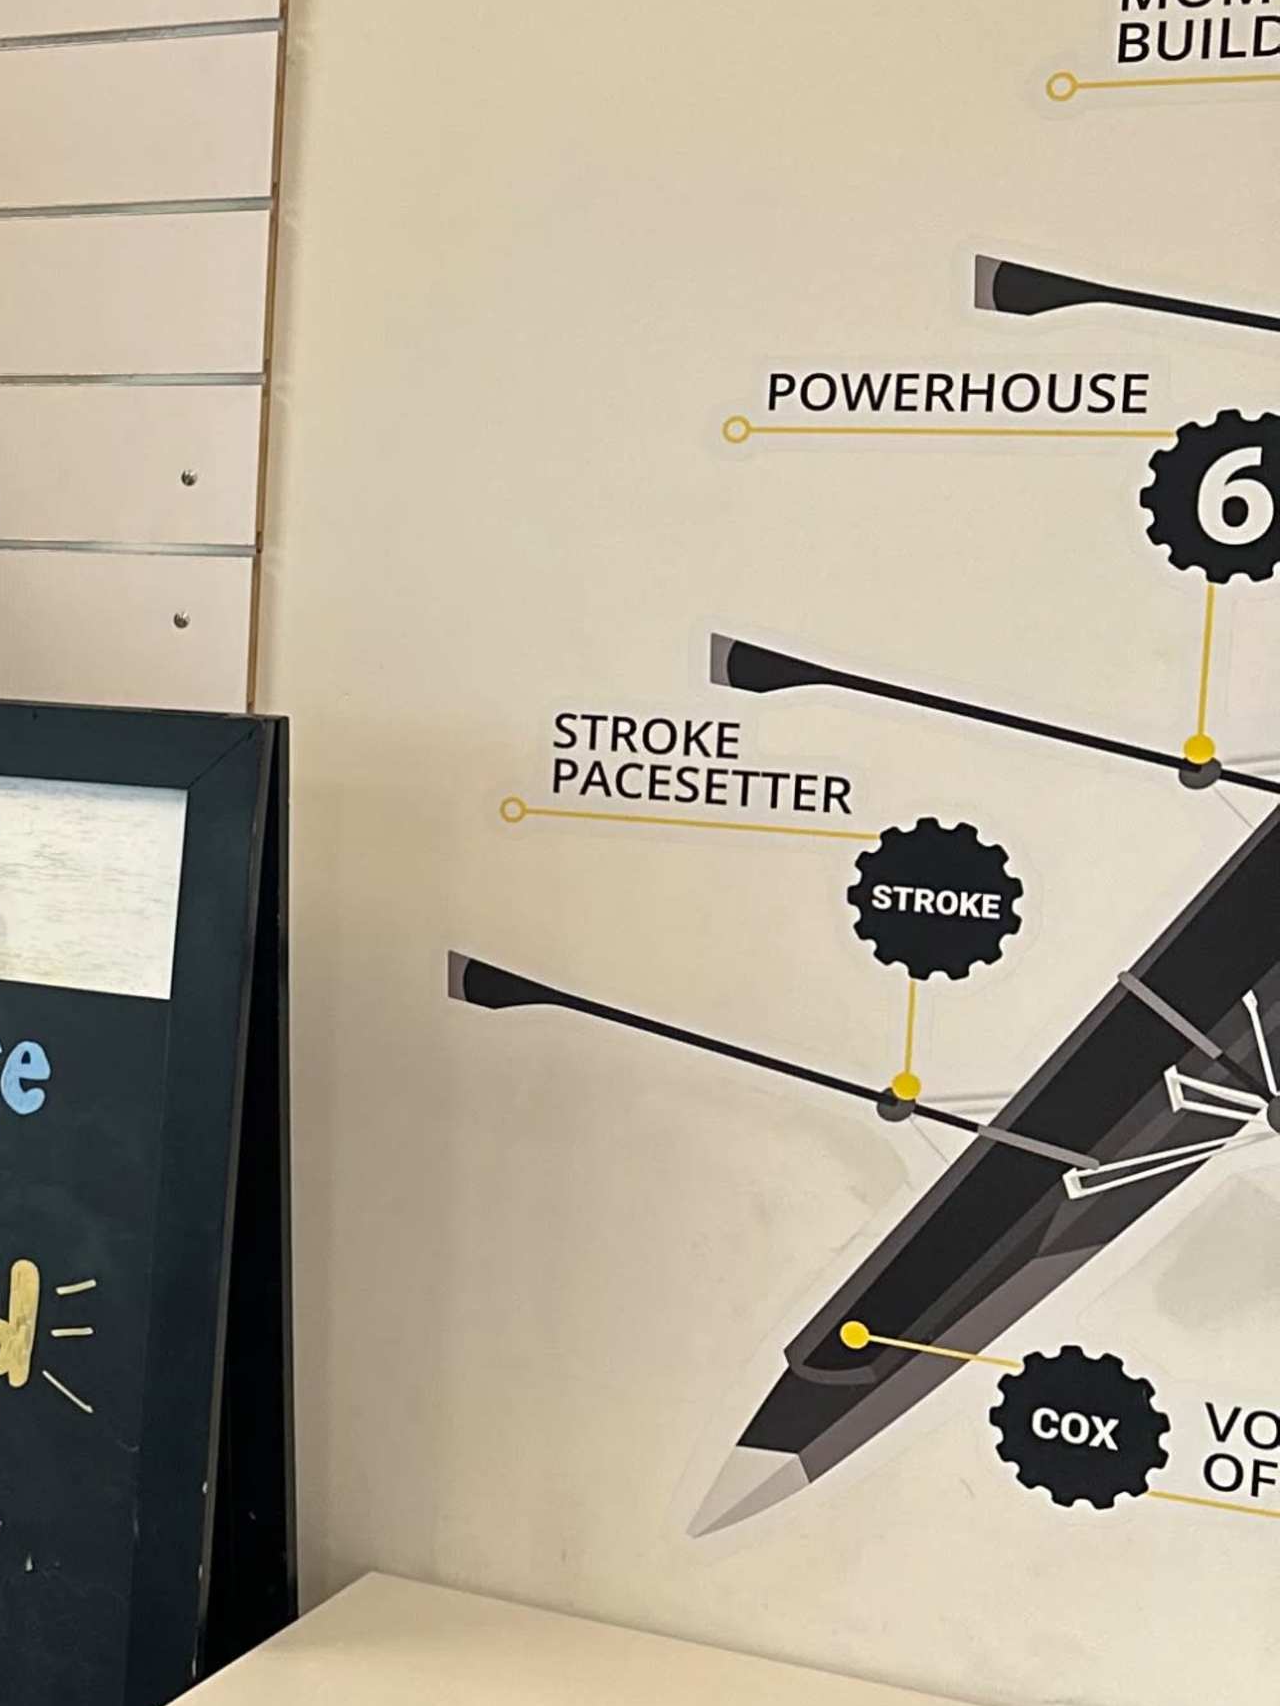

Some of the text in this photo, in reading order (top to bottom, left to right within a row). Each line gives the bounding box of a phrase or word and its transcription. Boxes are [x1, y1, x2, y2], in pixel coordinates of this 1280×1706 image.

[767, 372, 1150, 414] POWERHOUSE
[1197, 445, 1274, 545] 6
[553, 712, 741, 760] STROKE
[551, 759, 853, 815] PACESETTER
[872, 883, 1001, 921] STROKE
[1032, 1407, 1119, 1450] COX
[1203, 1453, 1278, 1497] OF
